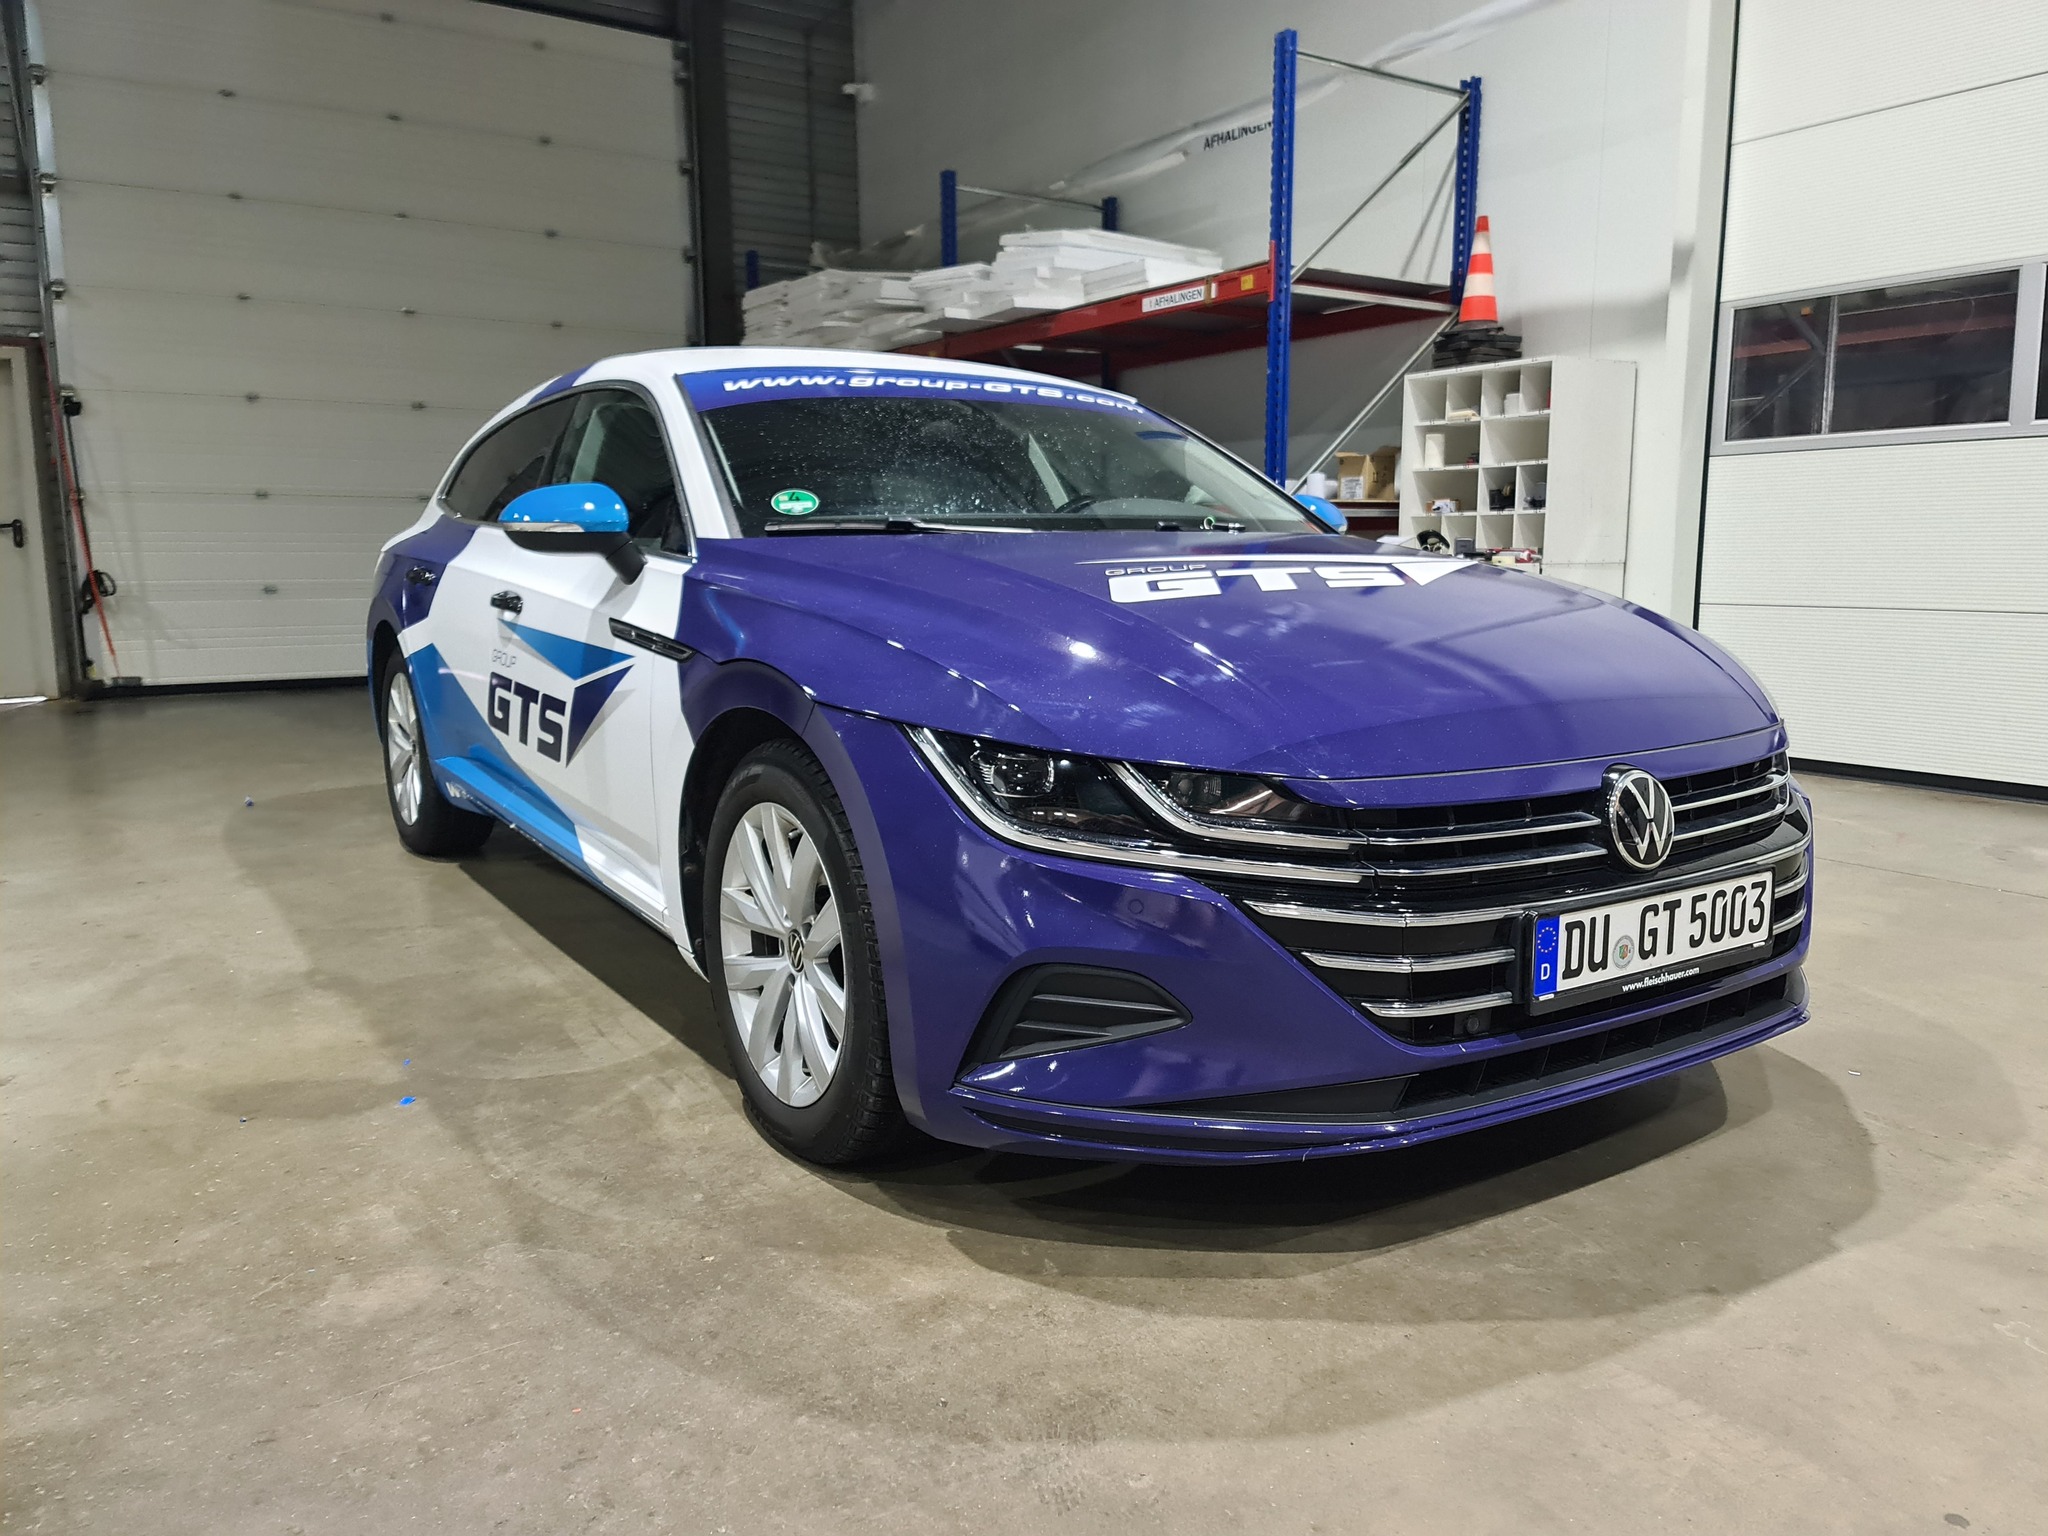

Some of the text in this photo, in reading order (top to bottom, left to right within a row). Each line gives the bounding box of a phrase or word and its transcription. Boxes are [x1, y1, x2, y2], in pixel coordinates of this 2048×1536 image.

[723, 373, 1144, 414] www.group-GTS.com
[1105, 563, 1207, 577] GROUP
[1107, 566, 1406, 604] GTS
[491, 648, 517, 669] GROUP
[487, 671, 567, 763] GTS
[1562, 914, 1610, 980] DU
[1638, 898, 1682, 960] GT
[1689, 881, 1767, 948] 5003
[1540, 963, 1551, 981] D
[1621, 967, 1700, 992] www.fleischhauer.com
